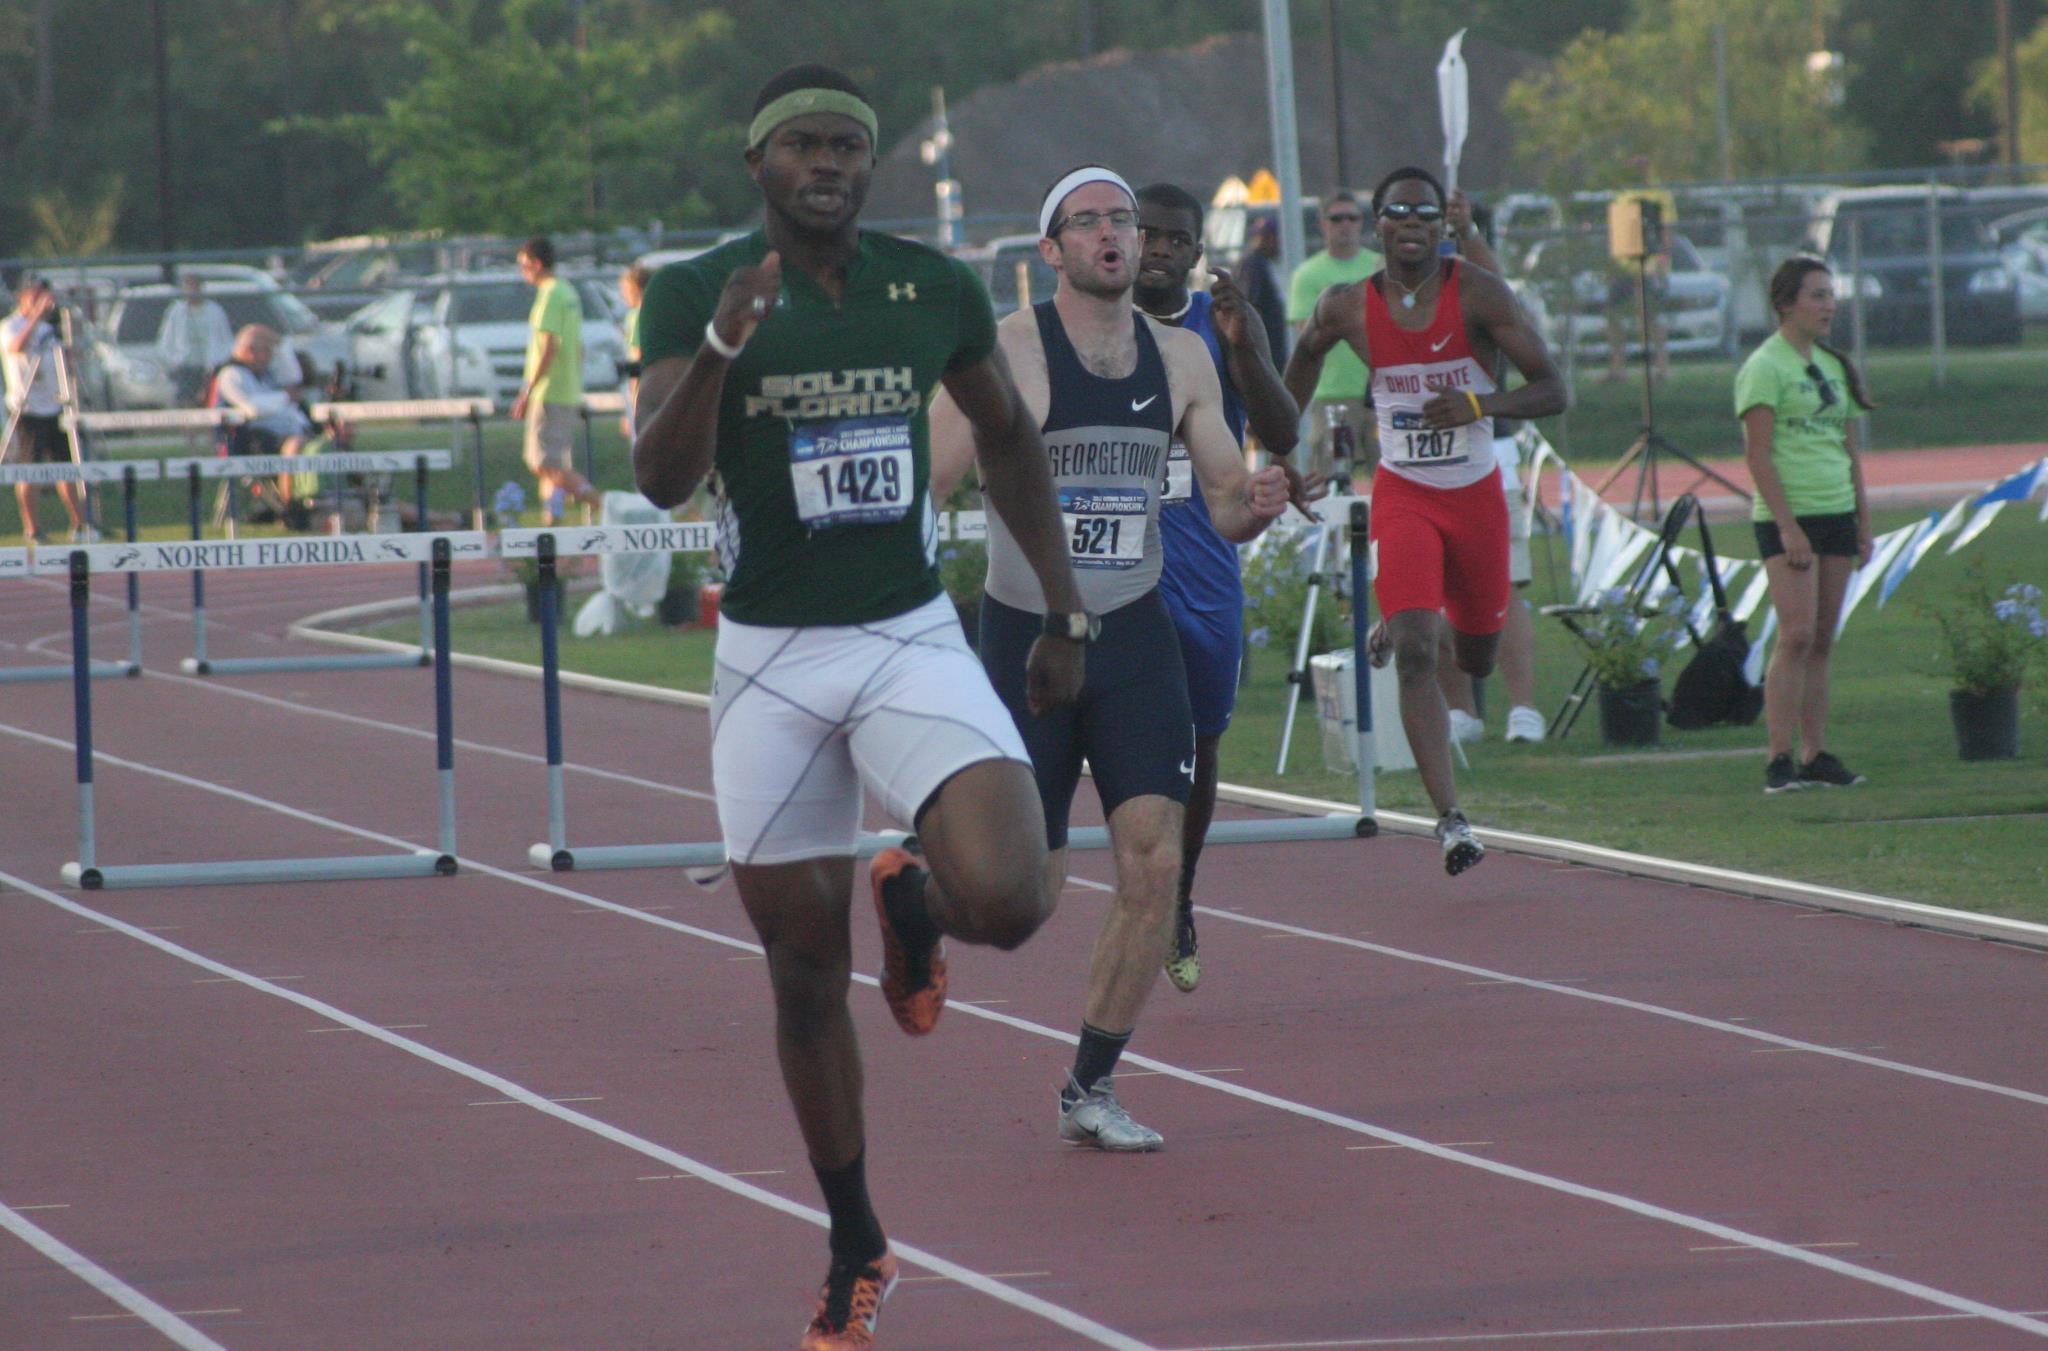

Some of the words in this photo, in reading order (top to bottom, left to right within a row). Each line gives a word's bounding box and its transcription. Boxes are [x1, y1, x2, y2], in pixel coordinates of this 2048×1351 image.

[761, 366, 913, 397] SOUTH
[1385, 374, 1420, 393] OHIO
[1426, 365, 1471, 389] STATE
[745, 391, 921, 417] FLORIDA
[1405, 430, 1455, 458] 1207
[816, 456, 901, 508] 1429
[624, 527, 710, 550] NORTH
[1071, 517, 1121, 555] 521
[157, 544, 244, 568] NORTH
[258, 541, 365, 565] FLORIDA
